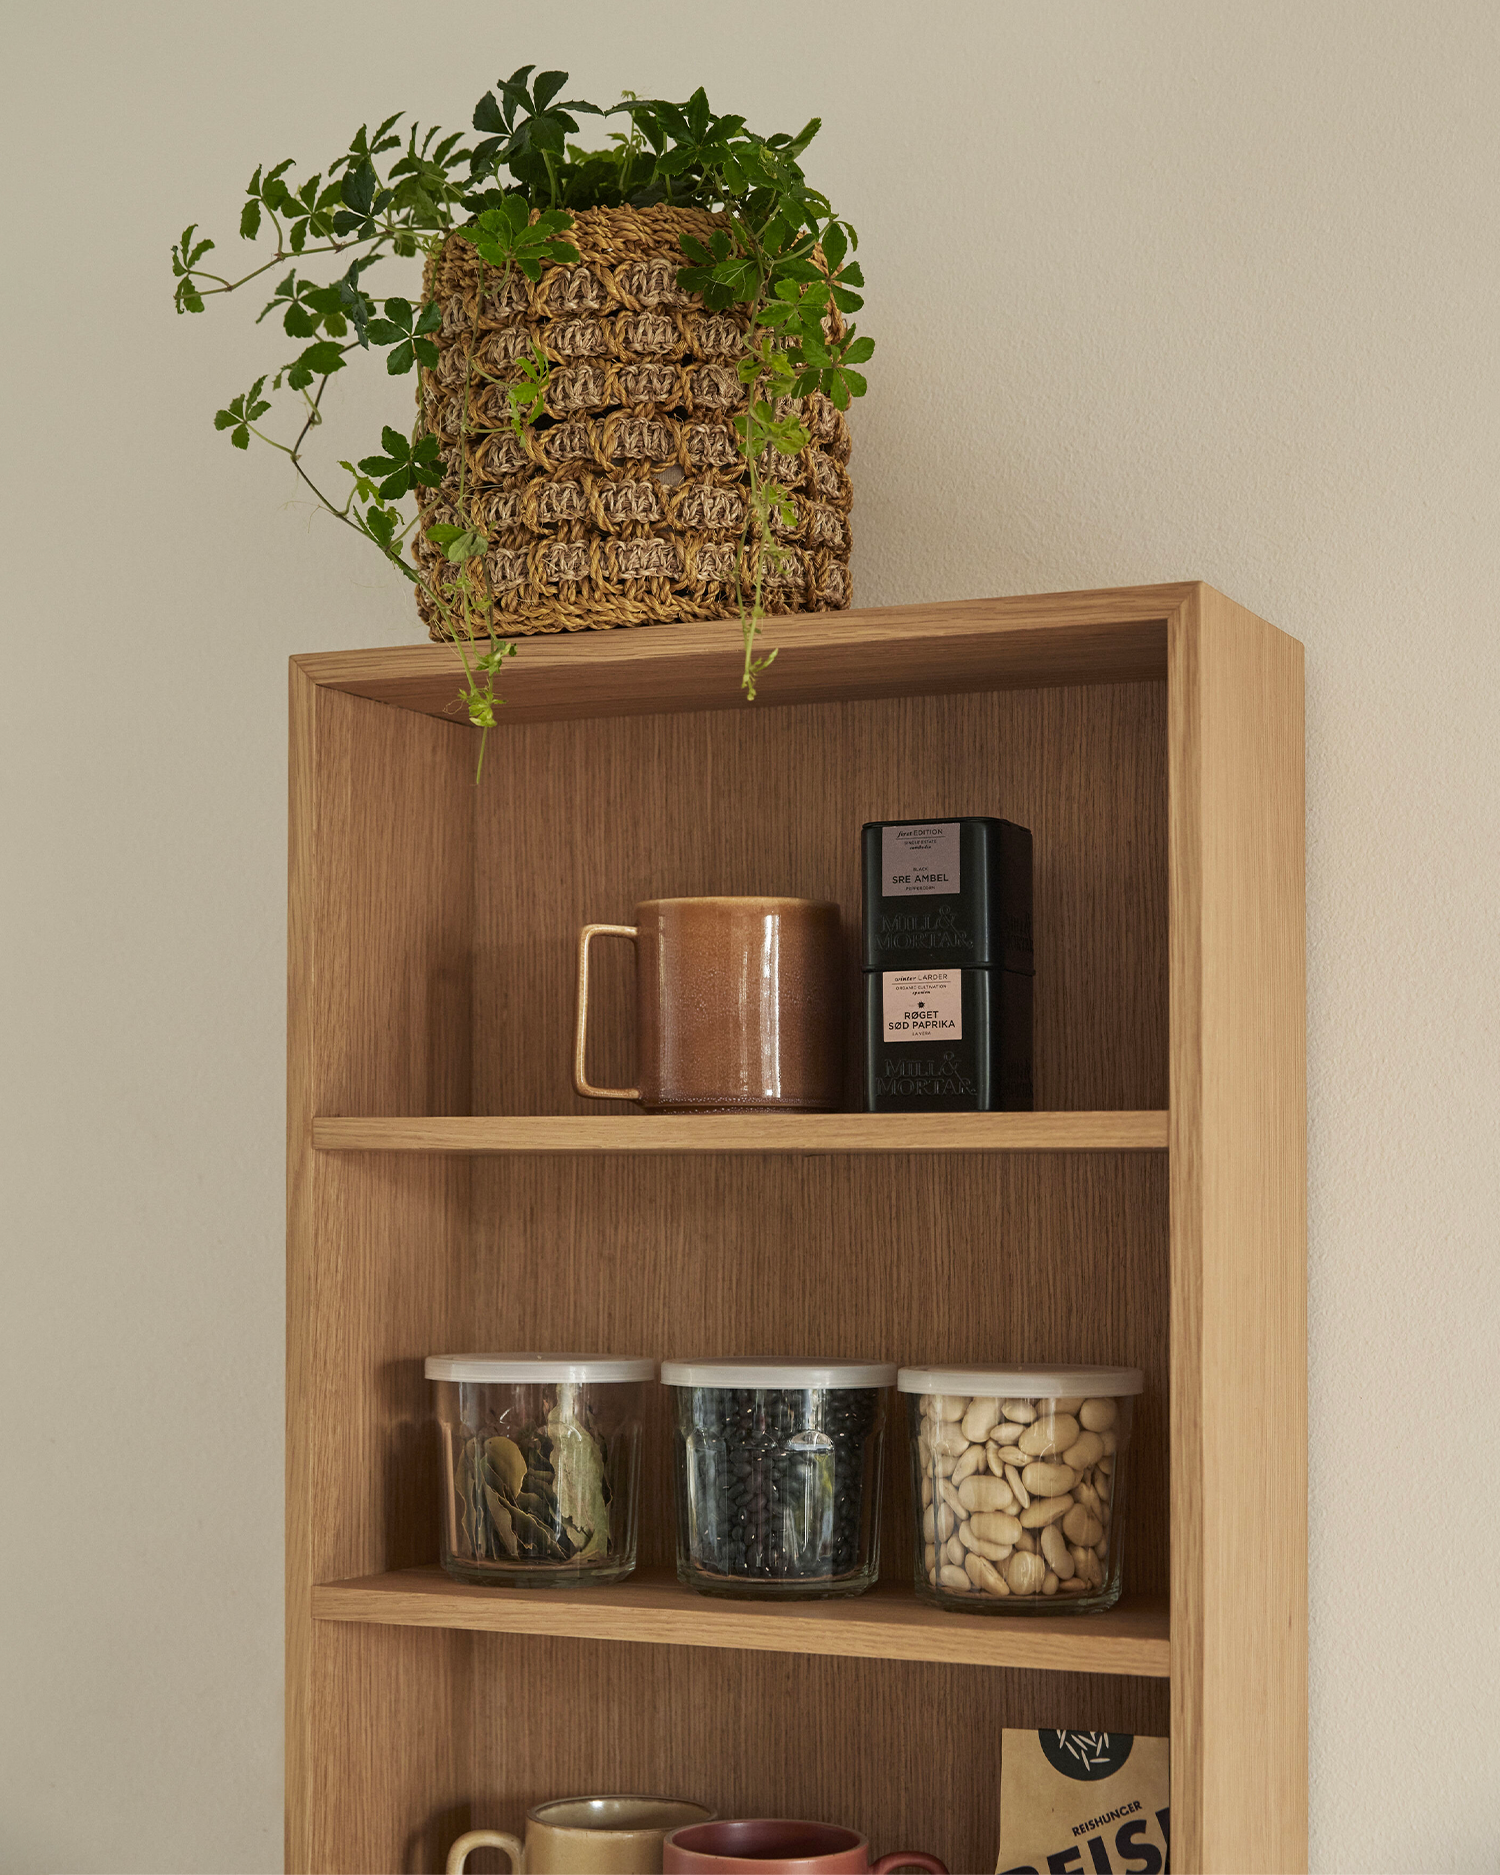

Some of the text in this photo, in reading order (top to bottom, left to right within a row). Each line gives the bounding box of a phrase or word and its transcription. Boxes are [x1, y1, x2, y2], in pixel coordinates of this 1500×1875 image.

[892, 874, 949, 884] SRE AMBEL
[904, 1011, 939, 1020] RØGET
[888, 1020, 956, 1030] SØD PAPRIKA
[1071, 1800, 1143, 1837] REISHUNGER
[996, 1807, 1170, 1875] EIS
